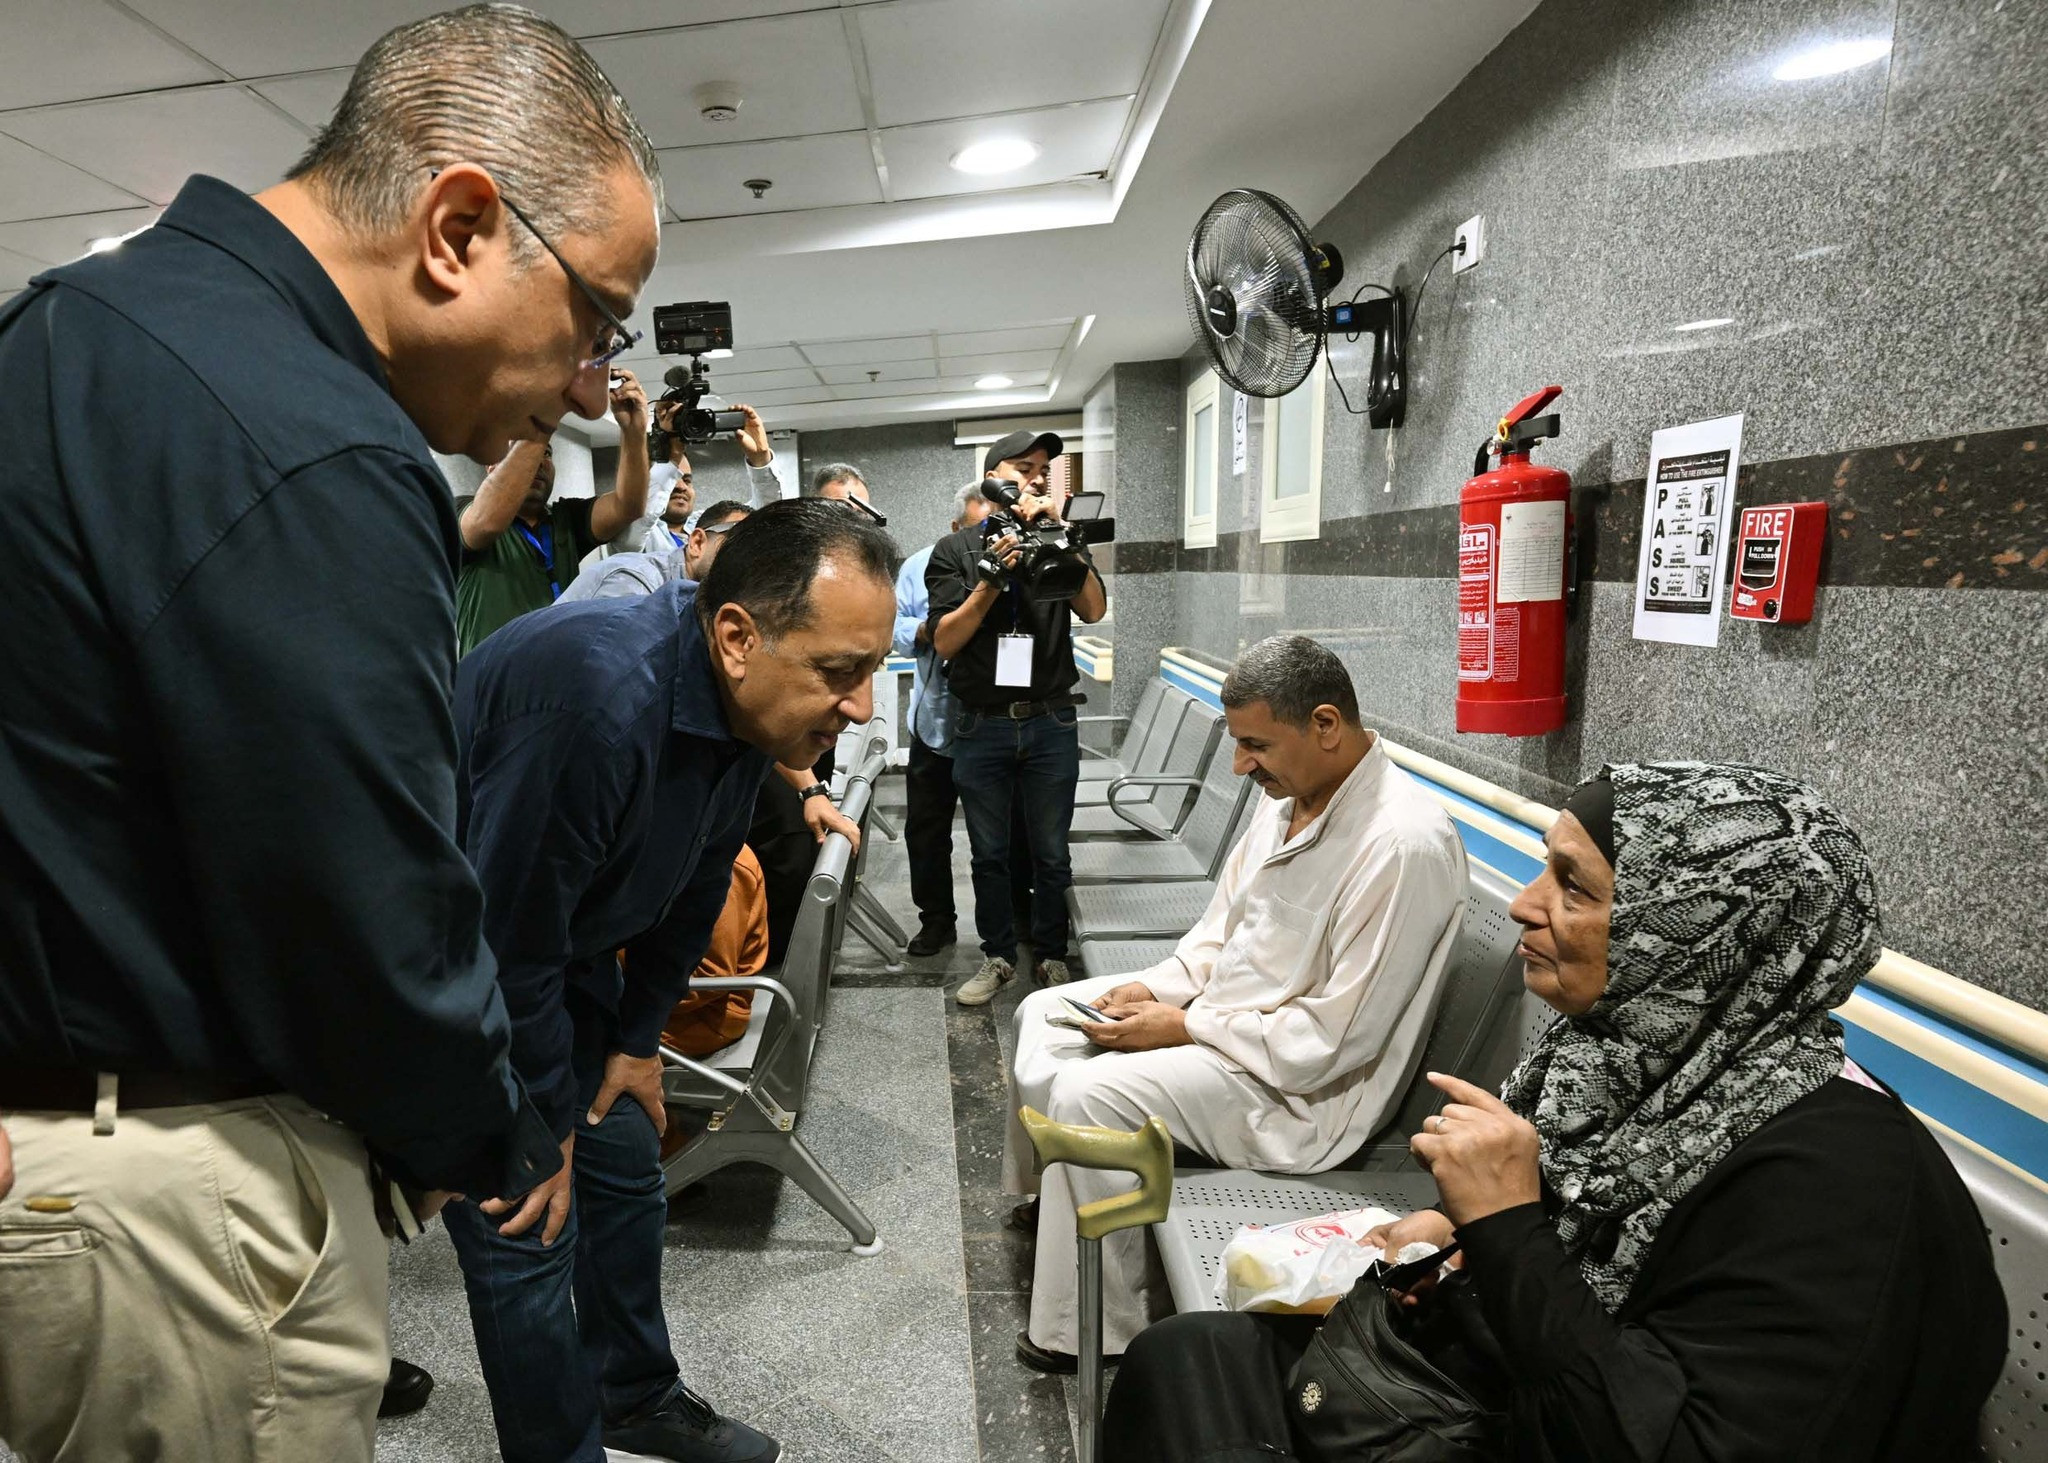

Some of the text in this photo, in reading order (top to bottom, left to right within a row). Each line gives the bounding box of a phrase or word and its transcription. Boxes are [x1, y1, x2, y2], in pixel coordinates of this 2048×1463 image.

[1649, 489, 1668, 596] P A S S
[1745, 512, 1787, 536] FIRE
